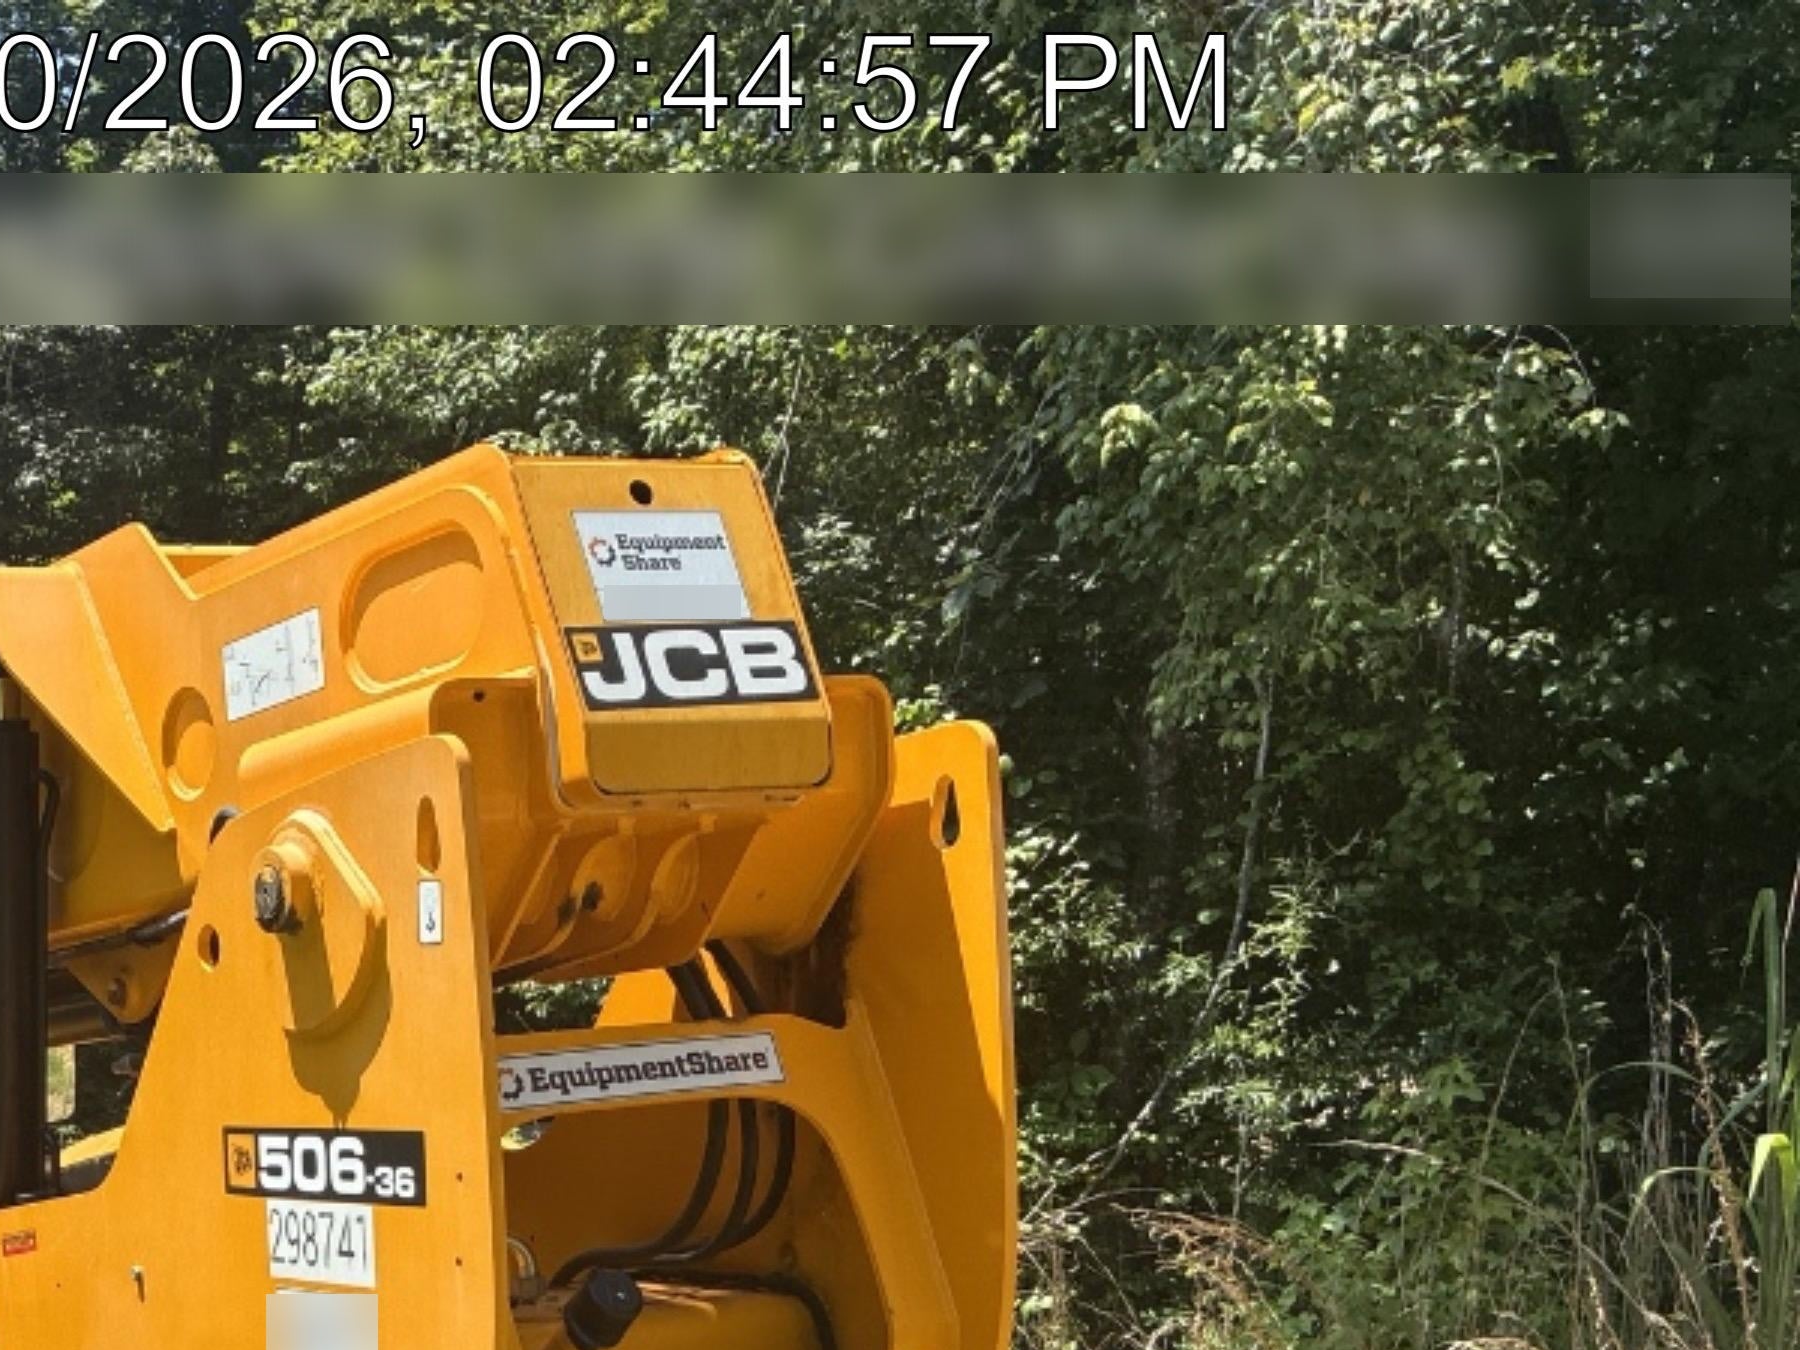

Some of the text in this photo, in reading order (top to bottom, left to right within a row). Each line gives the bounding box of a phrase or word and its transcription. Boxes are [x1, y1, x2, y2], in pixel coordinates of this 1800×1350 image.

[614, 533, 726, 553] Equipment
[620, 554, 682, 571] Share
[581, 626, 808, 702] JCB
[527, 1051, 769, 1095] EquipmentShare
[257, 1133, 416, 1198] 506-36
[269, 1207, 367, 1272] 298741
